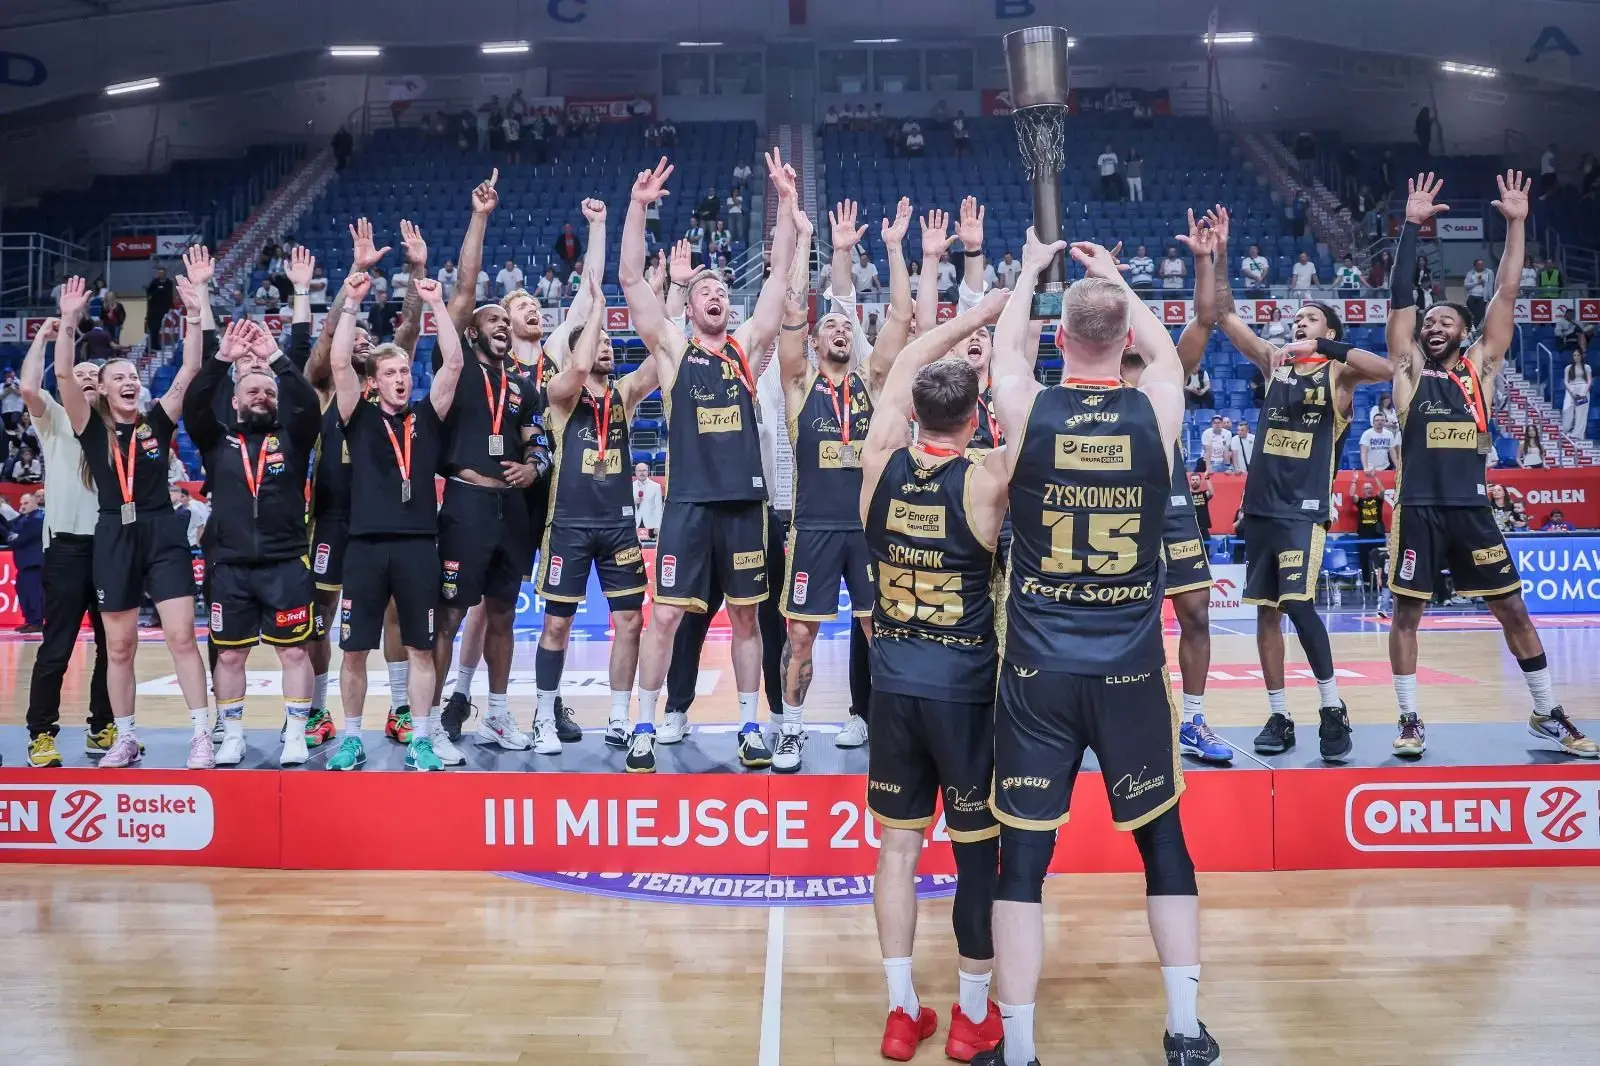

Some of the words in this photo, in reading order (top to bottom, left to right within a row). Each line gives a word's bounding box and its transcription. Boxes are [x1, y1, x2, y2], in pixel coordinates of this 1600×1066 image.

[1526, 27, 1581, 63] A
[1454, 224, 1478, 232] ORLEN
[1303, 386, 1327, 406] 11
[711, 411, 739, 425] Trefl
[1064, 412, 1093, 428] SPY
[1095, 412, 1119, 422] GUY
[1447, 428, 1475, 441] Trefl
[1080, 443, 1123, 456] Energa
[1280, 436, 1309, 452] Trefl
[1042, 484, 1143, 508] ZYSKOWSKI
[1527, 489, 1585, 504] ORLEN
[908, 511, 939, 524] Energa
[1041, 510, 1141, 575] 15
[1181, 544, 1199, 553] Trefl
[744, 554, 762, 564] Trefl
[888, 543, 945, 569] SCHENK
[753, 573, 765, 581] 4F
[1286, 573, 1303, 581] 4F
[878, 560, 964, 626] 55
[1021, 577, 1073, 602] Trefl
[1080, 581, 1153, 605] Sopot
[287, 610, 306, 621] Trefl
[879, 782, 901, 794] GUY
[1002, 776, 1022, 789] SPY
[1023, 776, 1051, 789] GUY
[117, 793, 196, 814] Basket
[485, 798, 534, 845] III
[556, 798, 808, 849] MIEJSCE
[1364, 799, 1512, 834] ORLEN
[118, 818, 166, 844] Liga
